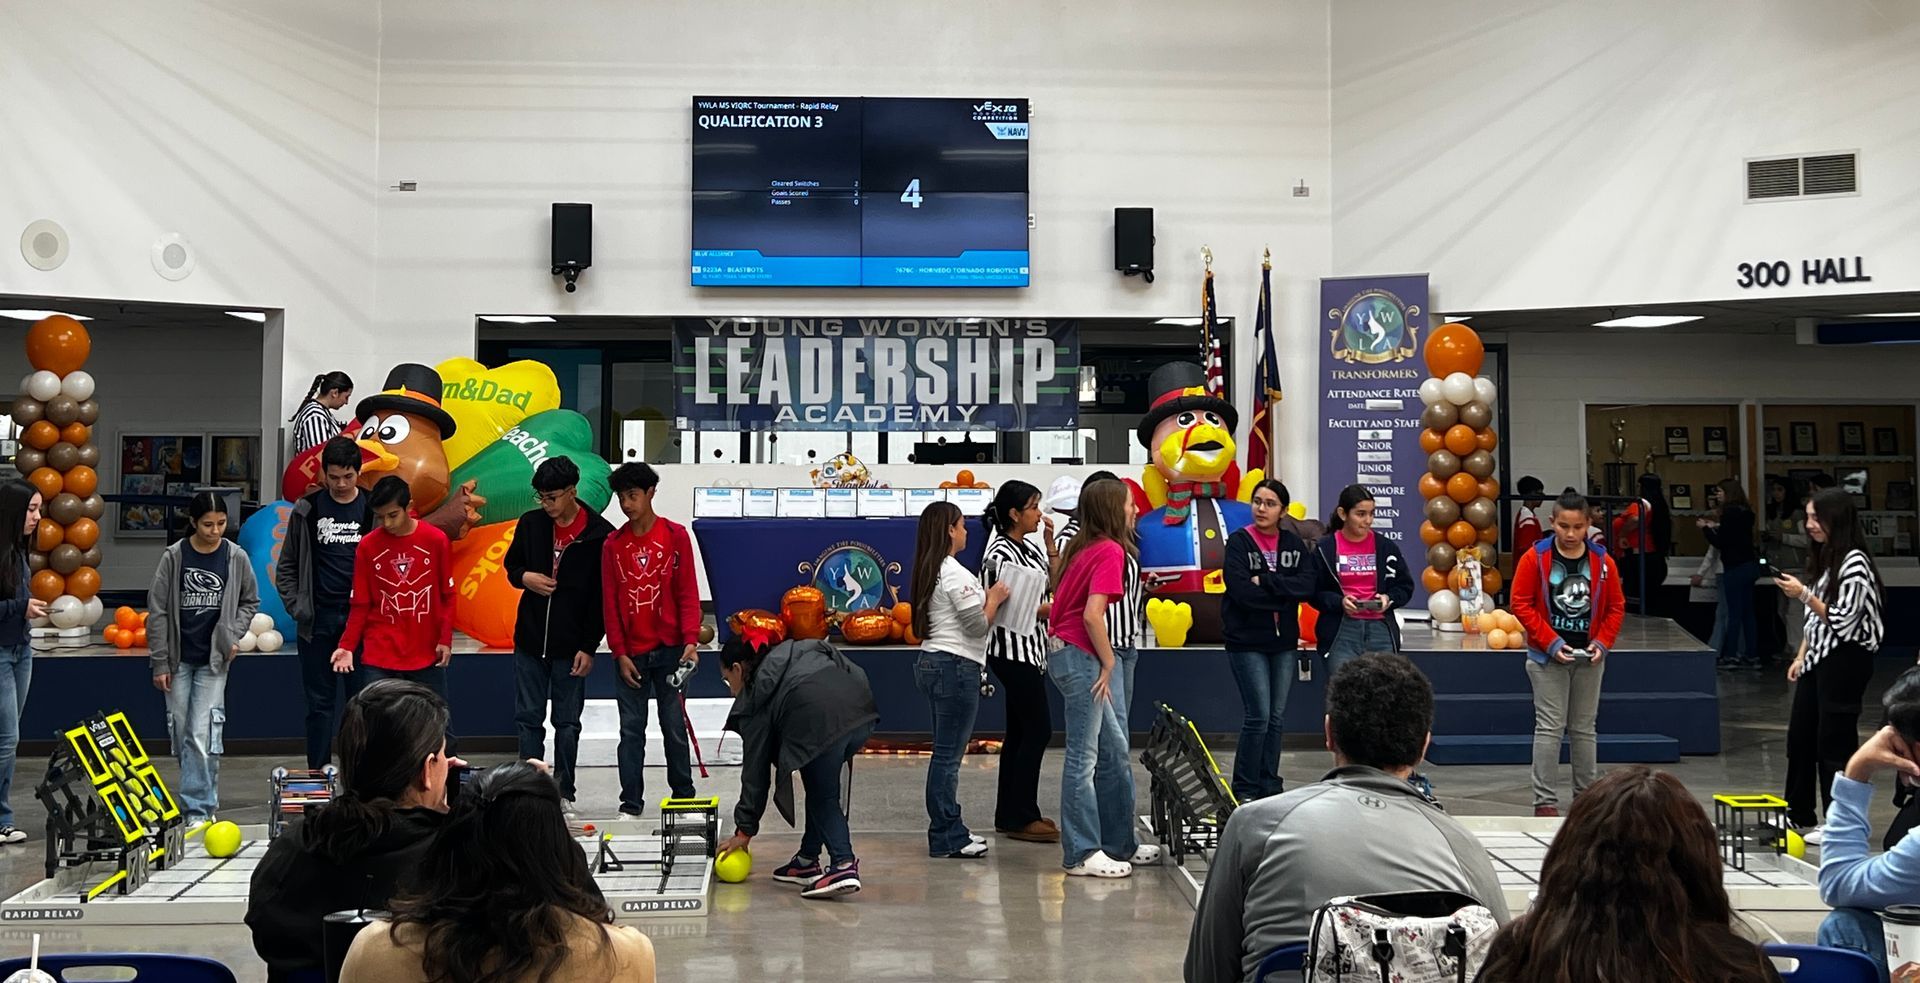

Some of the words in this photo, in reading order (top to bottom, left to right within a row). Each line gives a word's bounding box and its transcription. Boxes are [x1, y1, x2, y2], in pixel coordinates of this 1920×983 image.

[753, 102, 796, 110] Tournament
[800, 103, 819, 111] Rapid
[820, 103, 839, 111] Relay
[698, 115, 811, 129] QUALIFICATION
[814, 116, 824, 128] 3
[1007, 127, 1027, 137] NAVY
[900, 178, 923, 209] 4
[1736, 260, 1791, 289] 300
[1802, 256, 1872, 285] HALL
[705, 318, 844, 337] YOUNG
[855, 318, 1048, 337] WOMEN'S
[694, 337, 1056, 405] LEADERSHIP
[1331, 369, 1419, 380] TRANSFORMERS
[441, 377, 533, 412] m&Dad
[1327, 389, 1392, 399] ATTENDANCE
[774, 405, 980, 423] ACADEMY
[1328, 418, 1369, 428] FACULTY
[1369, 419, 1393, 428] AND
[1393, 418, 1420, 428] STAFF
[1357, 440, 1393, 450] SENIOR
[1357, 462, 1394, 474] JUNIOR
[1348, 554, 1377, 566] STE
[829, 567, 839, 580] Y
[857, 566, 872, 580] W
[831, 595, 839, 608] L
[860, 596, 870, 609] A
[626, 901, 659, 911] RAPID
[663, 900, 698, 910] RELAY
[4, 909, 40, 919] RAPID
[44, 909, 80, 919] RELAY
